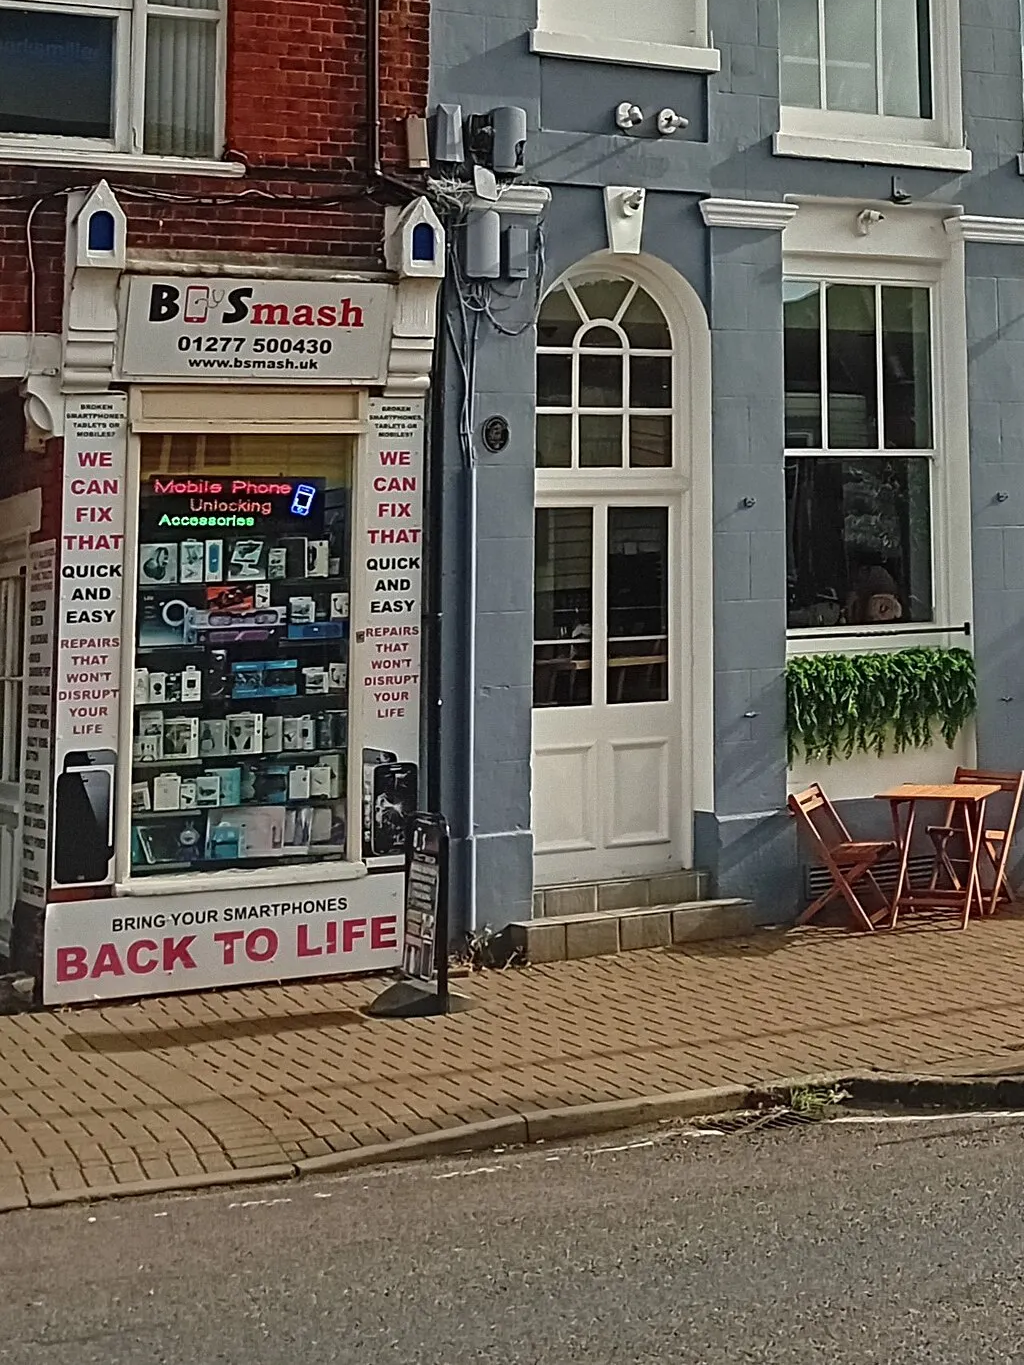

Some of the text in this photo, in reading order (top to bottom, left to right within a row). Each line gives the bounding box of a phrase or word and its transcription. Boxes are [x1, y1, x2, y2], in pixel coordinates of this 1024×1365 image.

[177, 336, 332, 354] 01277 500430
[188, 357, 318, 370] www.bsmash.uk
[78, 452, 113, 467] WE
[380, 451, 411, 465] WE
[71, 479, 118, 495] CAN
[154, 479, 293, 494] Mobile Phone
[373, 477, 416, 491] CAN
[190, 498, 272, 515] Unlocking
[378, 503, 411, 518] FIX
[76, 507, 113, 522] FIX
[158, 514, 255, 527] Accessories
[64, 535, 124, 550] THAT
[367, 529, 421, 544] THAT
[366, 557, 420, 570] QUICK
[62, 564, 122, 579] QUICK
[375, 579, 411, 591] AND
[72, 588, 111, 601] AND
[370, 600, 415, 613] EASY
[66, 610, 116, 624] EASY
[365, 626, 419, 637] REPAIRS
[61, 637, 120, 649] REPAIRS
[375, 643, 409, 653] THAT
[71, 655, 108, 665] THAT
[371, 659, 412, 669] WON'T
[66, 672, 112, 683] WON'T
[364, 675, 419, 686] DISRUPT
[59, 689, 120, 701] DISRUPT
[373, 691, 409, 702] YOUR
[69, 707, 108, 717] YOUR
[377, 708, 405, 718] LIFE
[73, 724, 103, 734] LIFE
[112, 897, 348, 932] BRING YOUR SMARTPHONES
[56, 915, 398, 982] BACK TO LIFE
